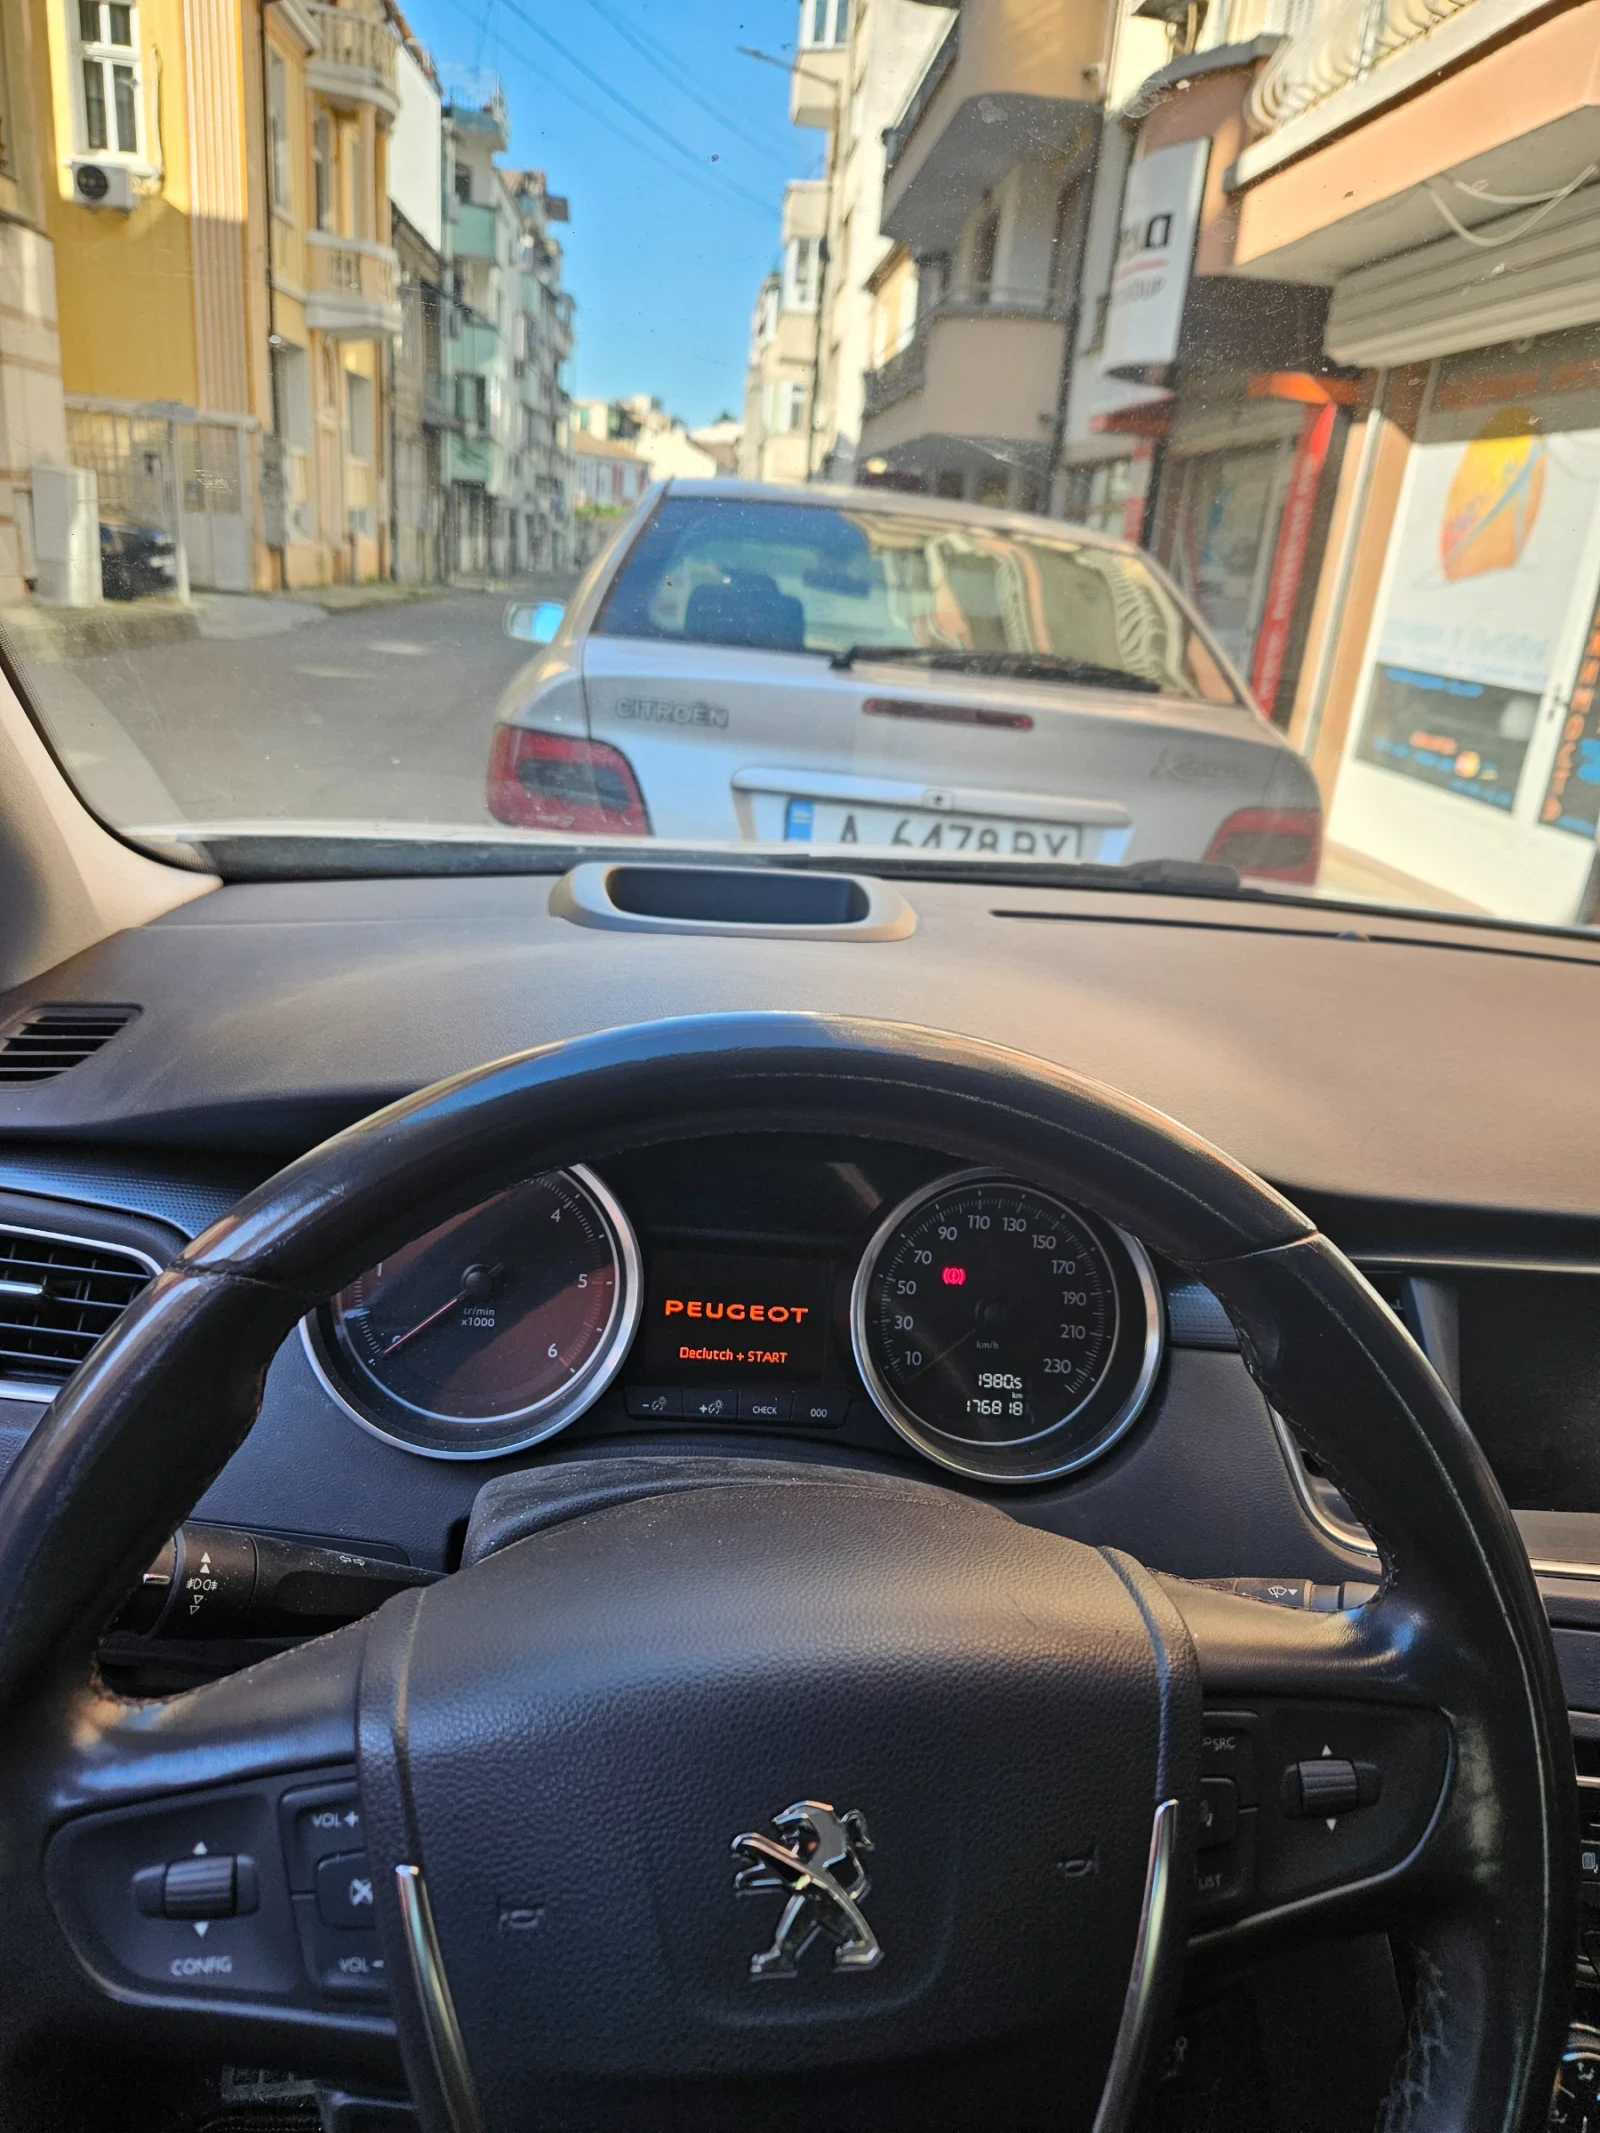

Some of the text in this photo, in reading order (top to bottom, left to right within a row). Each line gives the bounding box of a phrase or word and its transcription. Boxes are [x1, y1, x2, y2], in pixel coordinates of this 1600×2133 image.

[840, 814, 859, 843] A
[551, 1209, 561, 1223] 4
[968, 1215, 990, 1229] 110
[1003, 1217, 1026, 1232] 130
[938, 1227, 957, 1240] 90
[1032, 1235, 1056, 1249] 150
[914, 1250, 932, 1264] 70
[1051, 1260, 1076, 1275] 170
[578, 1274, 587, 1288] 5
[897, 1281, 916, 1295] 50
[1062, 1291, 1086, 1306] 190
[665, 1300, 808, 1323] PEUGEOT
[461, 1317, 495, 1327] x1000
[895, 1315, 913, 1330] 30
[1061, 1324, 1085, 1339] 210
[548, 1343, 557, 1358] 6
[977, 1340, 999, 1349] km/h
[680, 1347, 733, 1360] Declutch
[748, 1351, 787, 1363] START
[905, 1351, 921, 1365] 10
[1044, 1358, 1071, 1373] 230
[1011, 1391, 1023, 1399] km
[752, 1405, 778, 1415] CHECK
[171, 1956, 232, 1976] CONFIG
